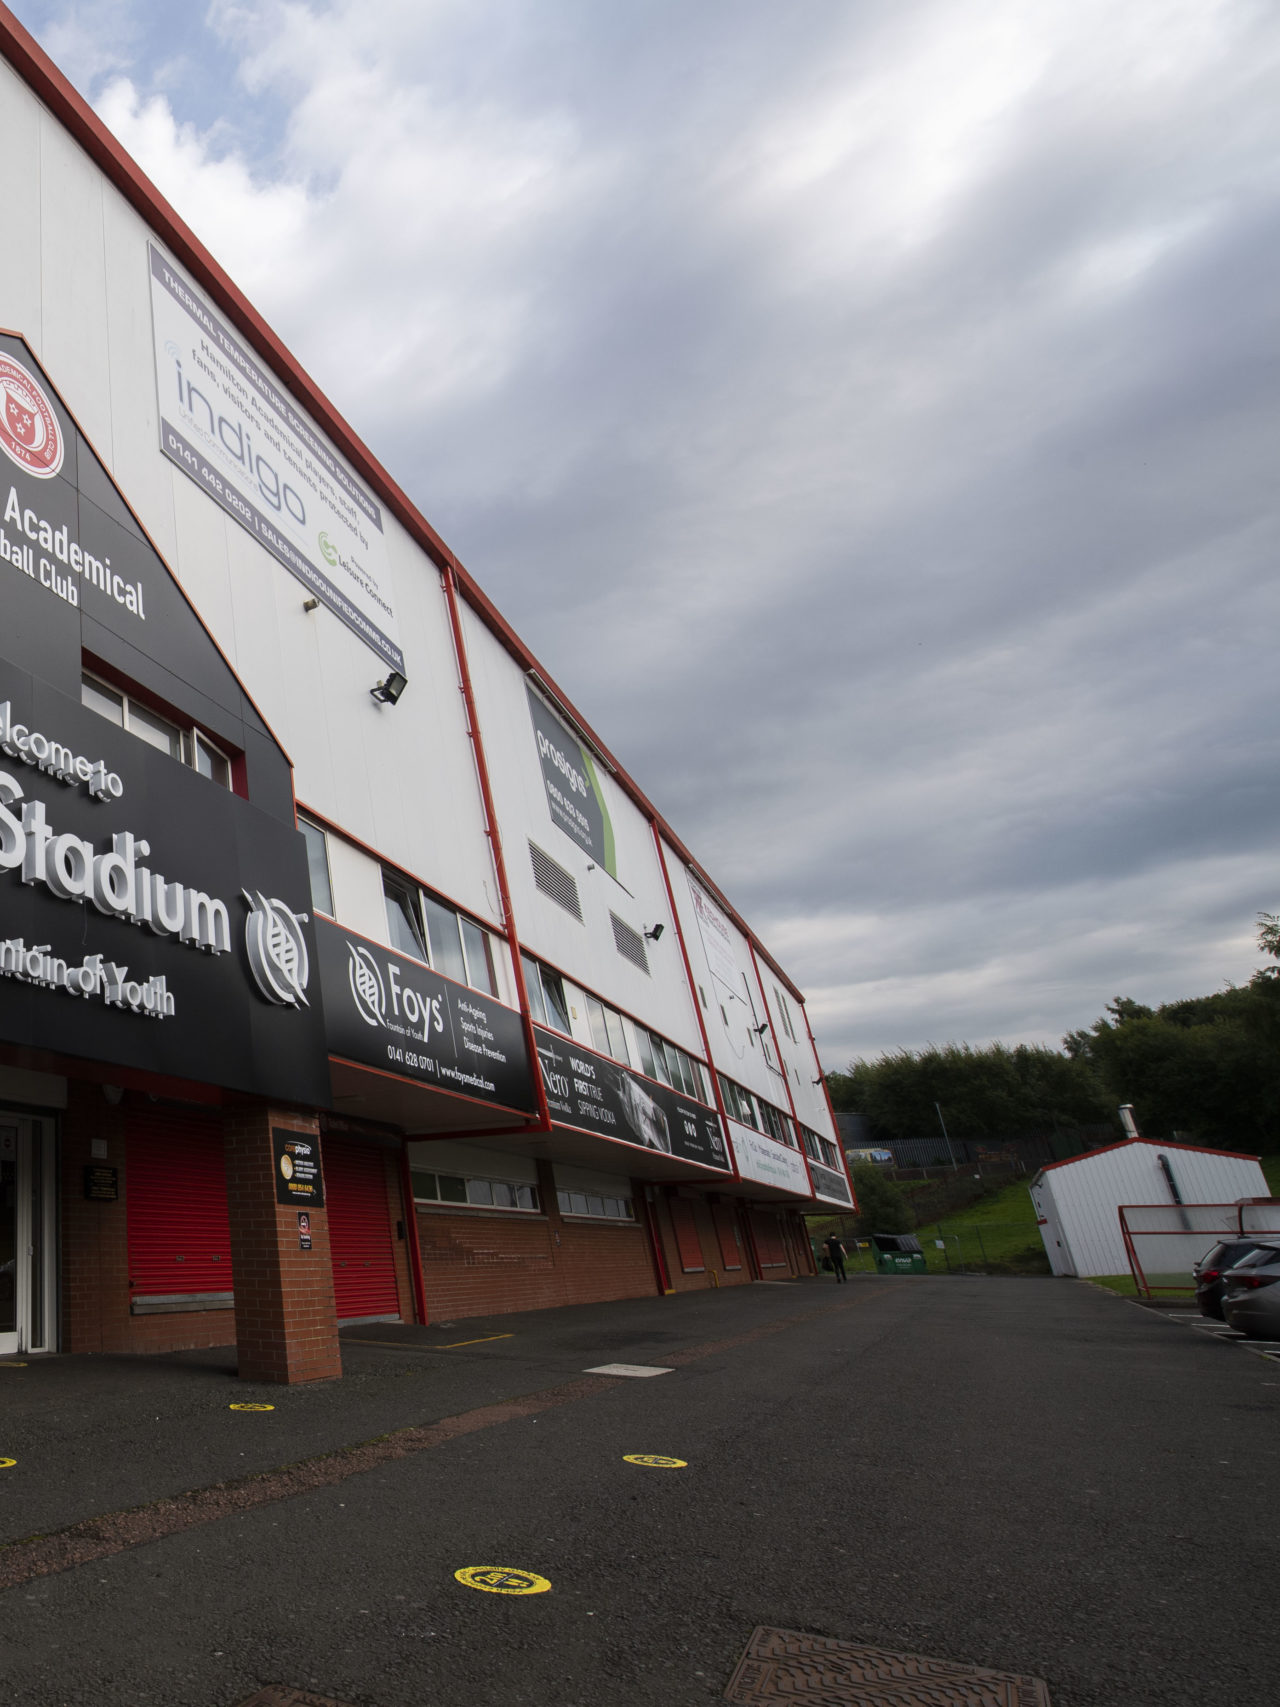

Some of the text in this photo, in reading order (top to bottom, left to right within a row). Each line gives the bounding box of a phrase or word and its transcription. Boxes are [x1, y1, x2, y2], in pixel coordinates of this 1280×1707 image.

[163, 268, 217, 337] THERMAL
[218, 331, 288, 417] TEMPERATURE
[336, 467, 376, 519] SOLUTIONS
[201, 339, 249, 400] Hamilton
[251, 393, 303, 461] Academical
[32, 391, 55, 440] FOOTBALL
[44, 440, 56, 460] CLUB
[176, 359, 307, 527] indigo
[192, 349, 369, 551] fans, visitors and tenants protected by
[11, 441, 31, 461] 1874
[168, 434, 199, 471] 0141
[202, 467, 224, 494] 442
[226, 490, 253, 520] 0202
[4, 486, 145, 620] Academical
[40, 558, 78, 607] Club
[338, 554, 394, 618] Leisure Connect
[89, 760, 124, 803] to
[537, 730, 587, 798] prosigns
[65, 953, 103, 999] of
[99, 961, 175, 1019] Youth
[387, 1018, 406, 1035] Fountain
[461, 1016, 494, 1041] Sports Injuries
[463, 1036, 507, 1064] Disease Prevention
[387, 1044, 404, 1063] 0141
[405, 1051, 418, 1067] 628
[419, 1055, 435, 1072] 0701
[441, 1066, 496, 1092] www.foysmedical.com
[538, 1056, 569, 1098] Nero
[569, 1056, 596, 1080] WORLD'S
[574, 1077, 604, 1101] FIRST TRUE
[577, 1099, 600, 1120] SIPPING
